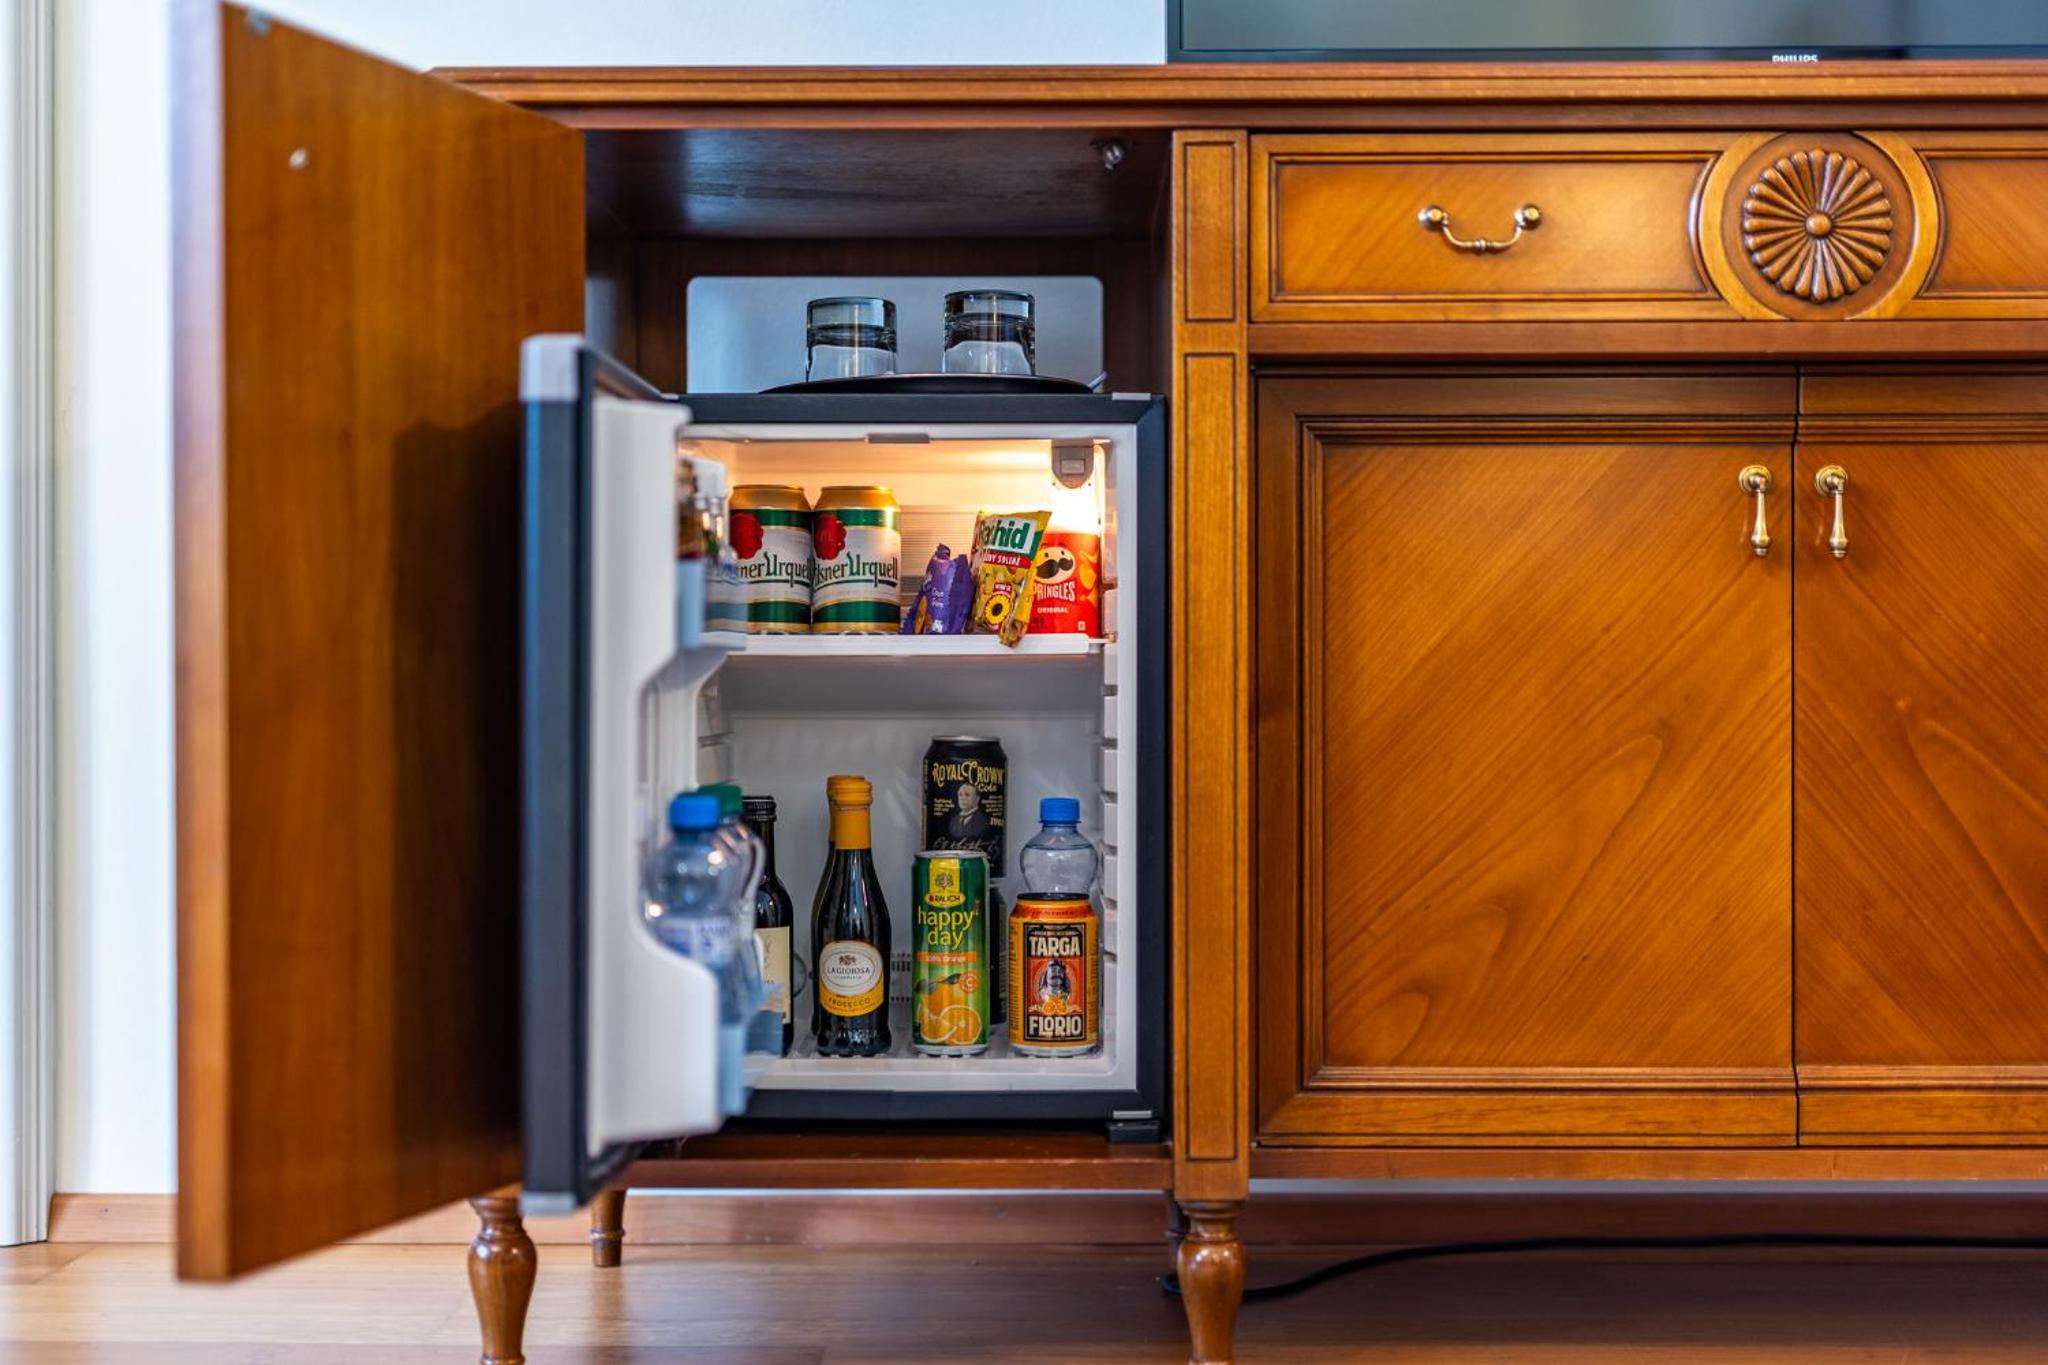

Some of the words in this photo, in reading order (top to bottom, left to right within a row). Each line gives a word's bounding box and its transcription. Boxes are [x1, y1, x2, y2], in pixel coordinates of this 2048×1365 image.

[1771, 54, 1818, 63] PHILIPS
[846, 550, 898, 588] Urquell
[918, 905, 974, 931] happy
[927, 927, 964, 951] day
[1029, 935, 1081, 957] TARGA
[1028, 1015, 1082, 1037] FLORIO
